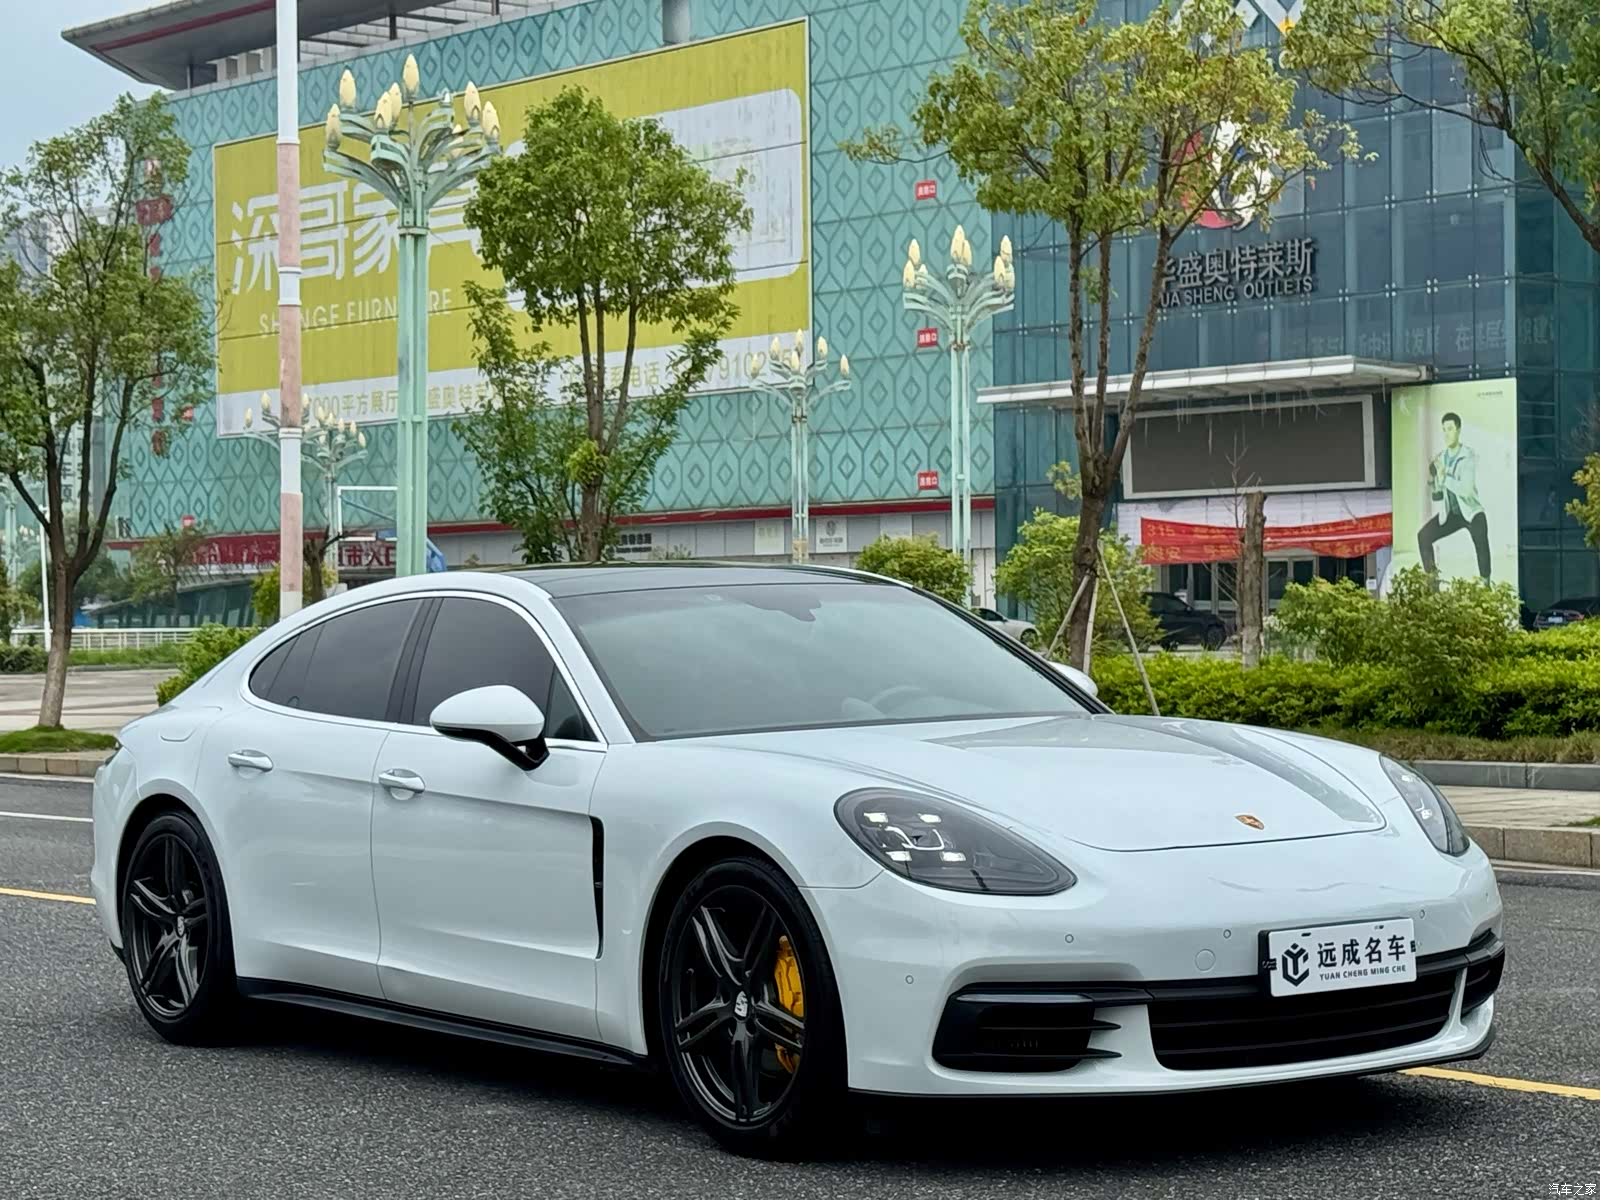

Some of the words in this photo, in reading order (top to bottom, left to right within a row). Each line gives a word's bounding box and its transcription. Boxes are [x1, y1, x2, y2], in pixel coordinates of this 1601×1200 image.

[1158, 291, 1181, 308] UA
[1184, 284, 1235, 305] SHENG
[1243, 275, 1313, 299] OUTLETS
[259, 302, 340, 339] SHNGE
[347, 288, 451, 325] FURNRE
[1317, 934, 1406, 968] 远成名车
[1319, 971, 1341, 981] YUAN
[1343, 968, 1368, 979] CHENG
[1370, 965, 1390, 975] MING
[1392, 964, 1407, 973] CHE
